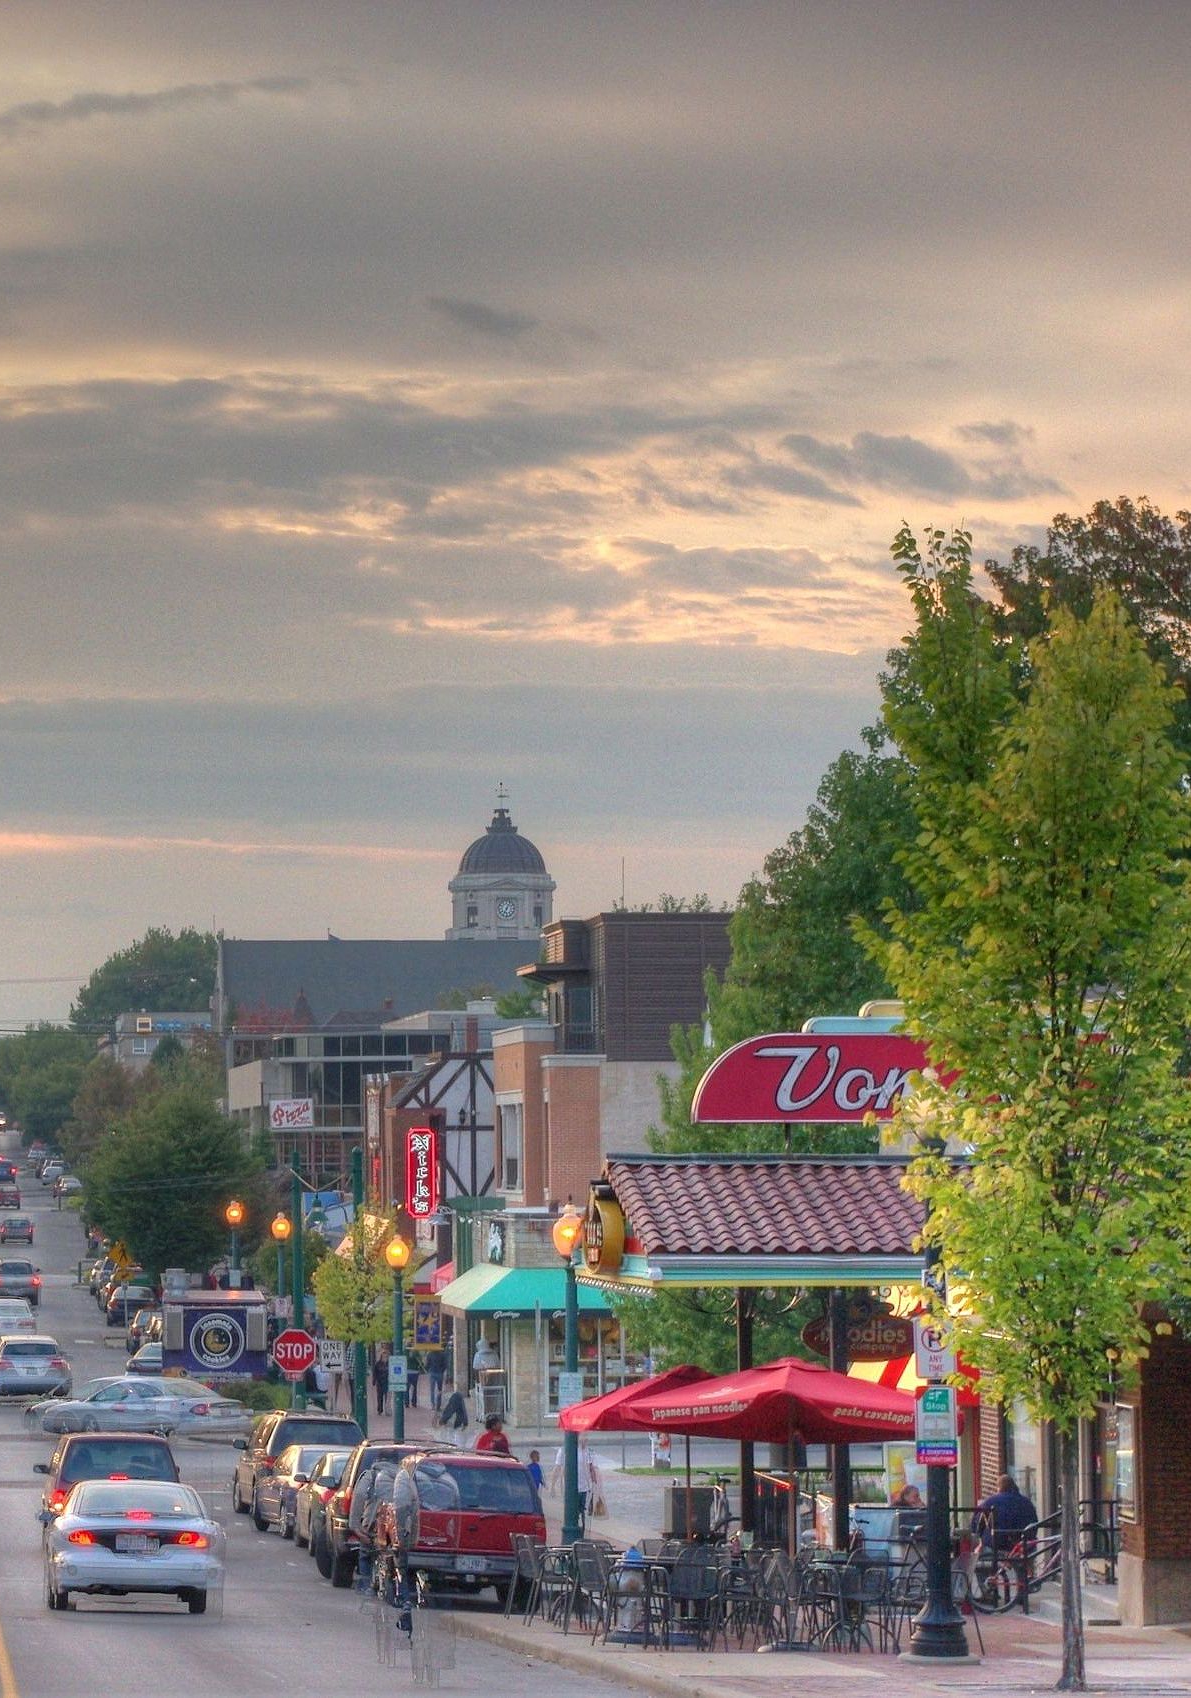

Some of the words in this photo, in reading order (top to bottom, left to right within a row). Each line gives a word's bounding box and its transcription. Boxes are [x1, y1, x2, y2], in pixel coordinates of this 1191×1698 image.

[272, 1101, 310, 1126] Pizza
[411, 1135, 431, 1214] Nick's
[276, 1343, 313, 1360] STOP
[322, 1342, 342, 1351] ONE
[322, 1352, 342, 1361] WAY
[929, 1354, 942, 1363] ANY
[928, 1364, 944, 1373] TIME
[693, 1406, 710, 1417] pan
[833, 1406, 863, 1418] pesto
[864, 1408, 914, 1425] cavatappi
